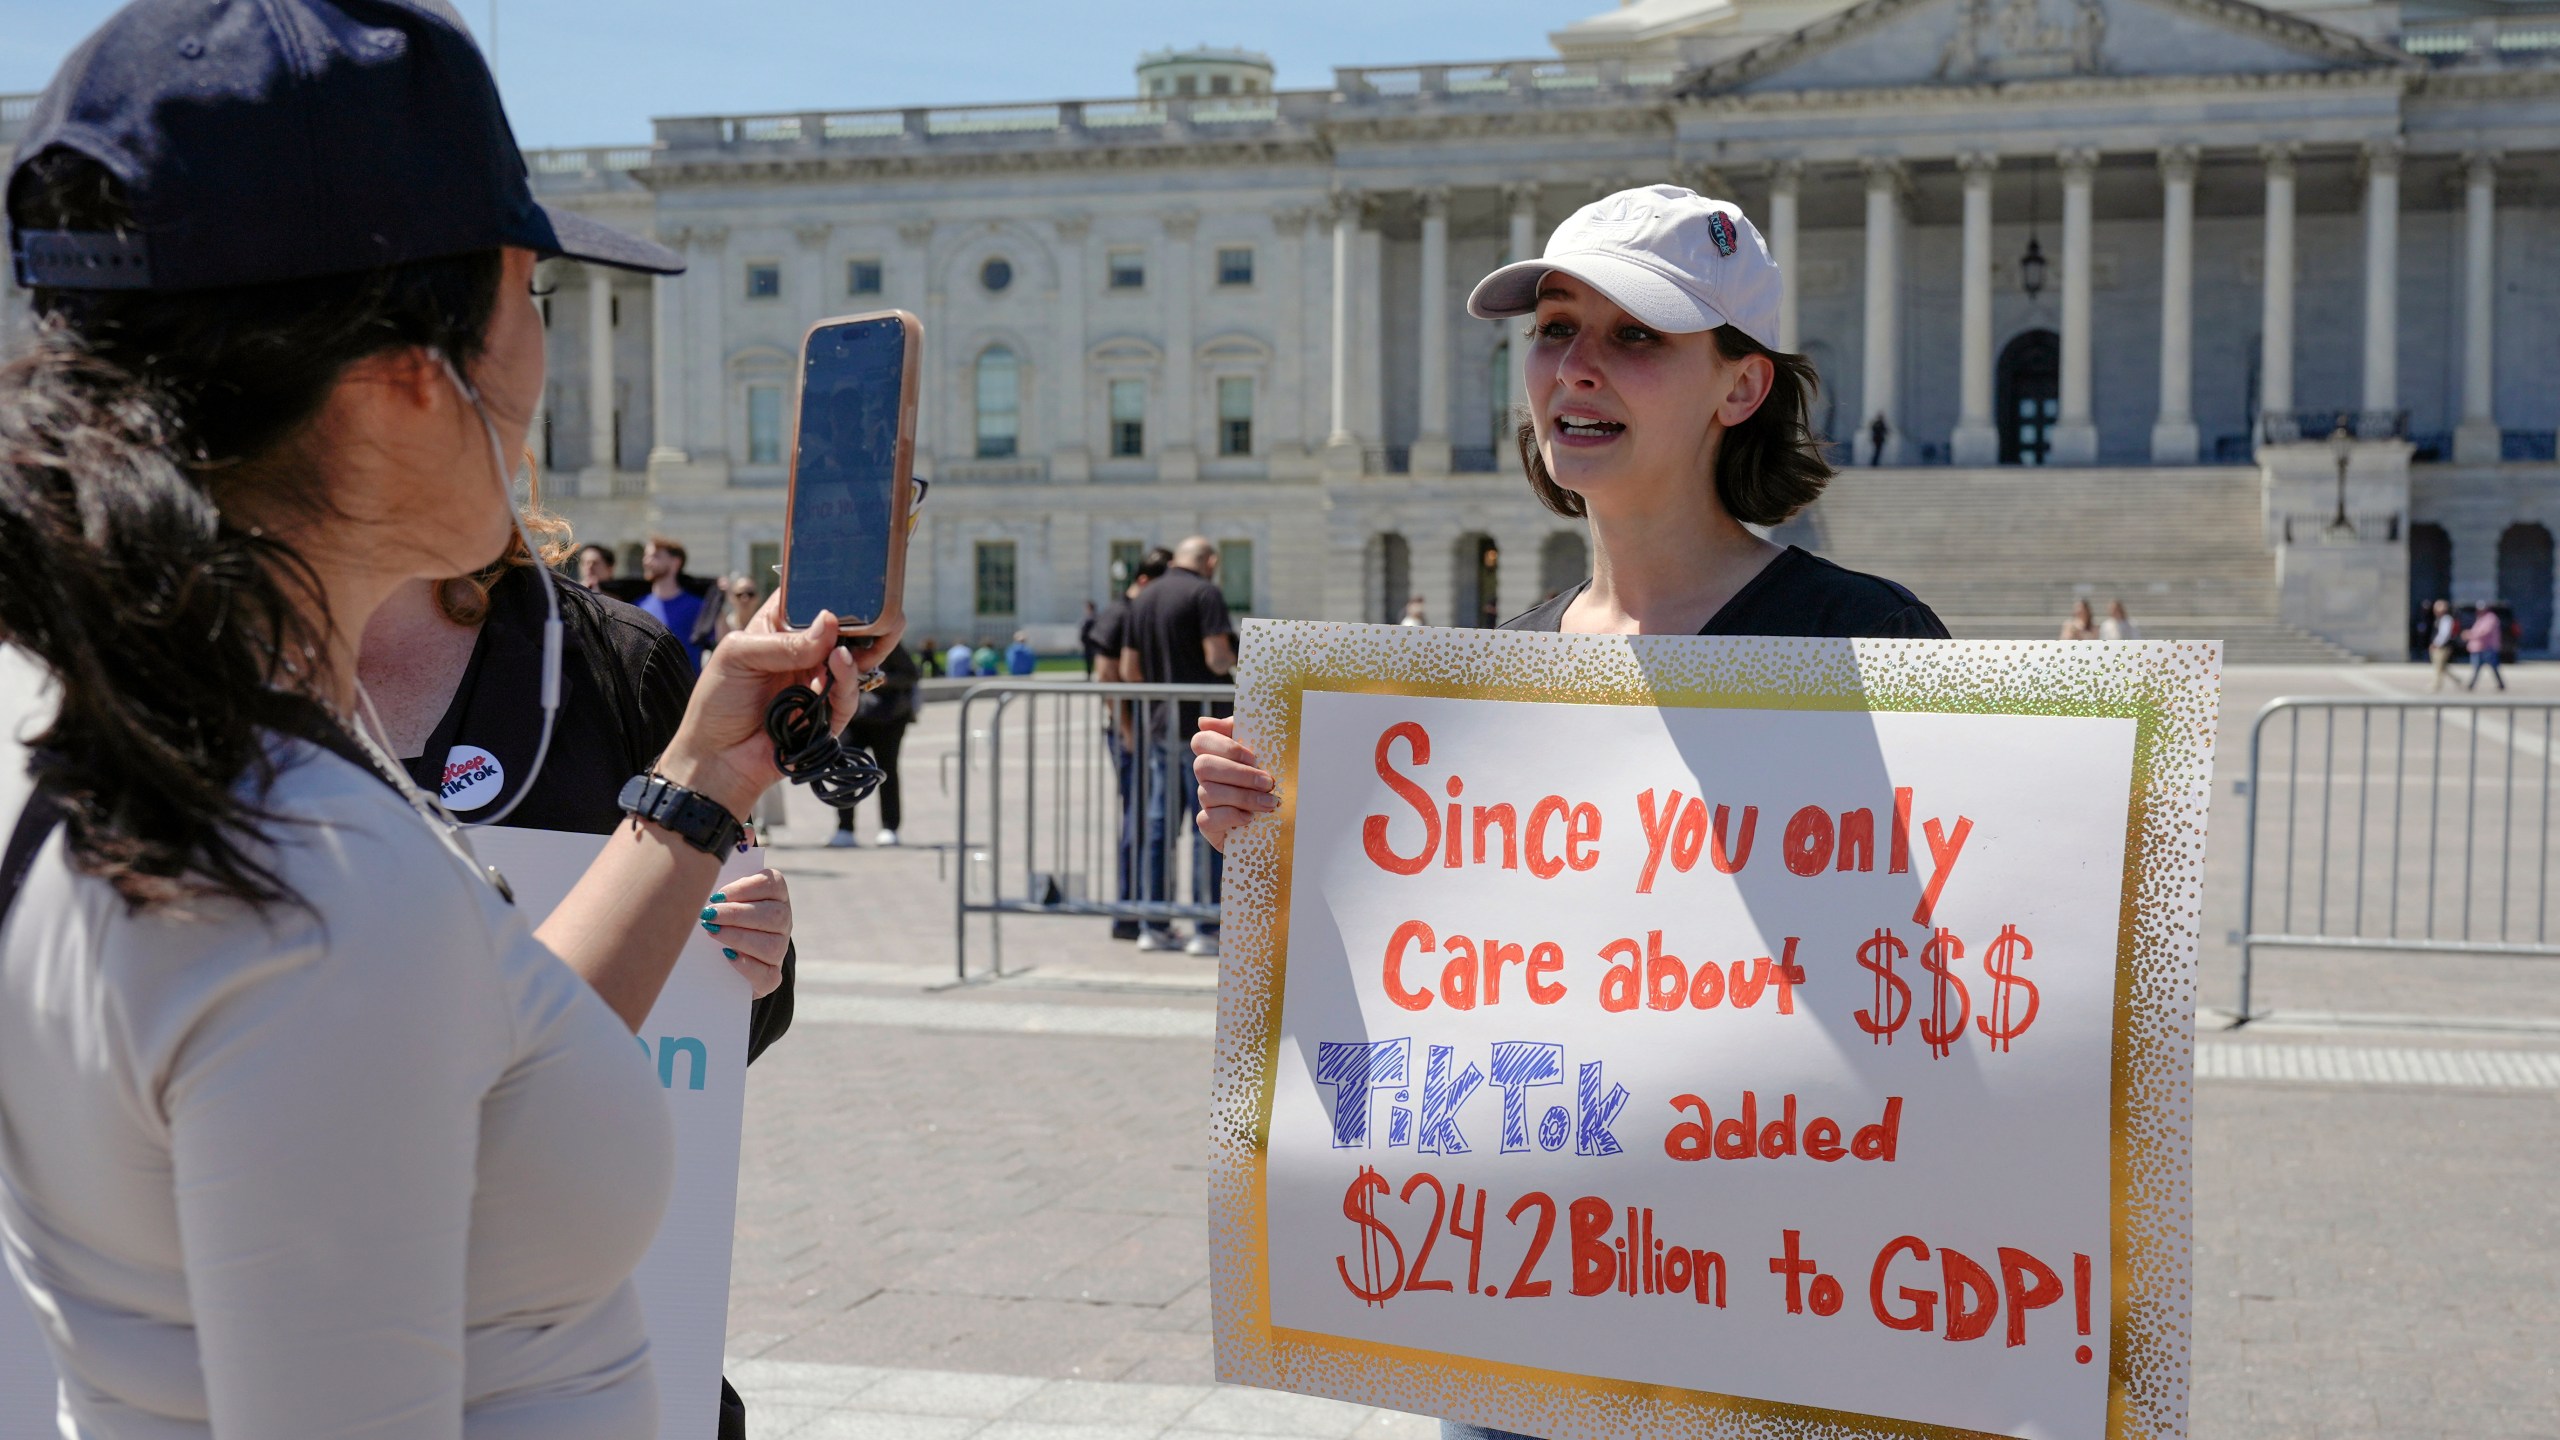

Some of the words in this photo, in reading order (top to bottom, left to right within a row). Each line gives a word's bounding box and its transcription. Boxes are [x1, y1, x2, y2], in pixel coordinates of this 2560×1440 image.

[440, 756, 486, 783] Keep
[440, 765, 498, 799] TikTok
[1363, 721, 1602, 880] Since
[1636, 788, 1758, 894] you
[1784, 786, 1974, 927] only
[1382, 919, 1568, 1012] Care
[1598, 930, 1806, 1015] about
[1854, 924, 2040, 1058] $$$
[634, 1035, 707, 1091] n
[1316, 1036, 1630, 1157] TikTok
[1664, 1090, 1903, 1162] added
[1337, 1165, 1557, 1306] $24.2
[1569, 1196, 1727, 1308] Billion
[1769, 1229, 1844, 1317] to
[1869, 1235, 2093, 1364] GDP!
